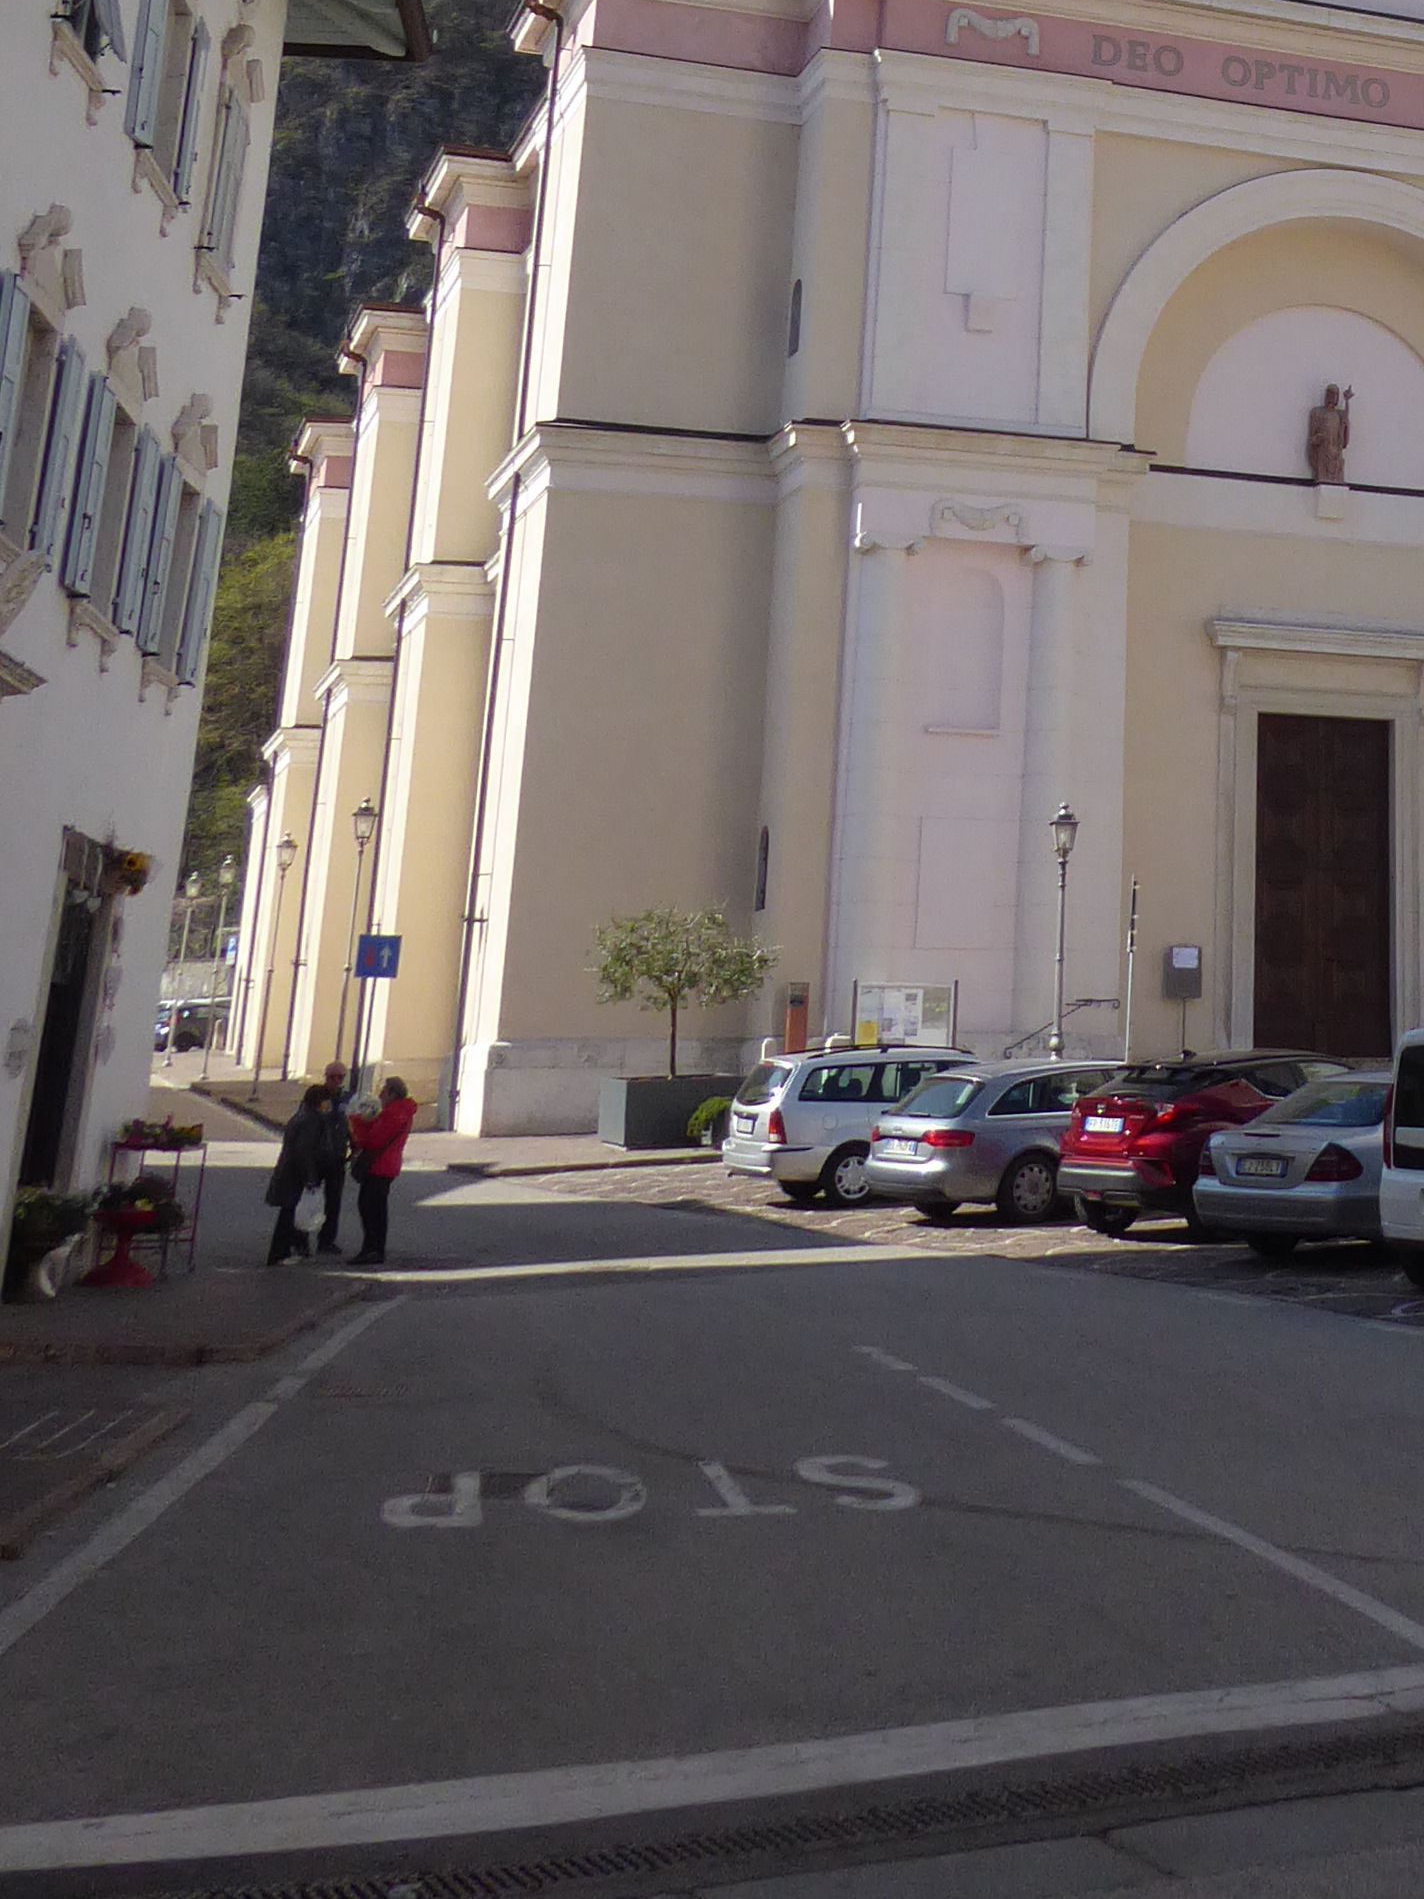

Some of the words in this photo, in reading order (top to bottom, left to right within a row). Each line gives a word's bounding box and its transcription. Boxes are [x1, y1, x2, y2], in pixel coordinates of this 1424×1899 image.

[1091, 34, 1184, 77] DEO
[1221, 55, 1391, 108] OPTIMO
[382, 1454, 922, 1528] STOP
